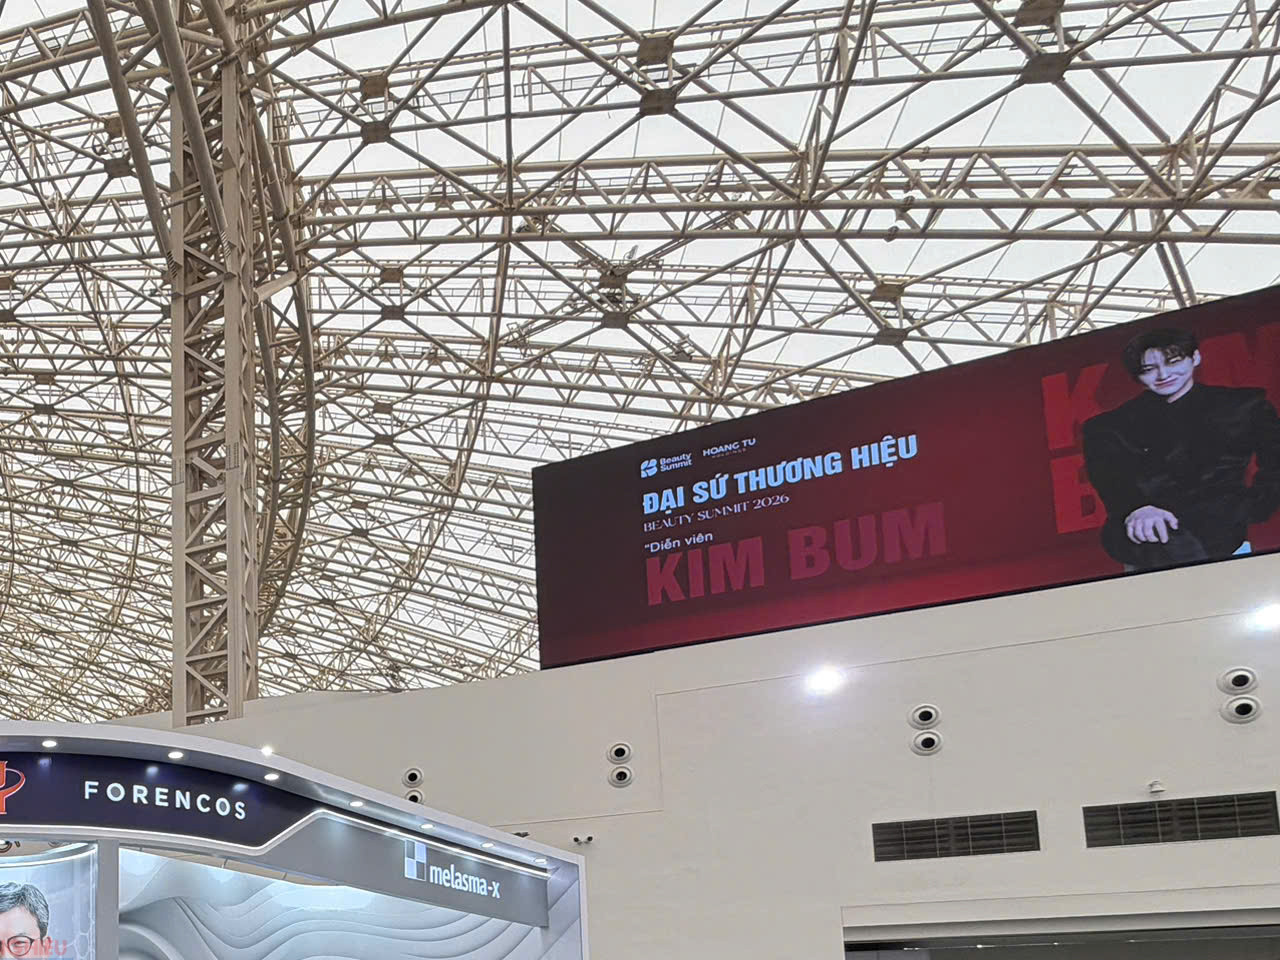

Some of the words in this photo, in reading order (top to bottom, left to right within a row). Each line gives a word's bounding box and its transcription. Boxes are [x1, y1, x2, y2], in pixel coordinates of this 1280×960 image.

[660, 453, 692, 465] Beauty
[660, 459, 693, 472] Summit
[702, 442, 740, 457] HOANG
[742, 437, 757, 447] TU
[642, 486, 685, 515] ĐẠI
[692, 473, 730, 504] SỨ
[733, 450, 843, 495] THƯƠNG
[850, 434, 919, 471] HIỆU
[643, 513, 695, 533] BEAUTY
[697, 501, 750, 522] SUMMIT
[752, 493, 790, 511] 2026
[646, 535, 766, 607] KIM
[787, 501, 948, 581] BUM
[684, 533, 714, 546] viên
[83, 780, 246, 820] FORENCOS
[429, 862, 501, 899] melasma-x
